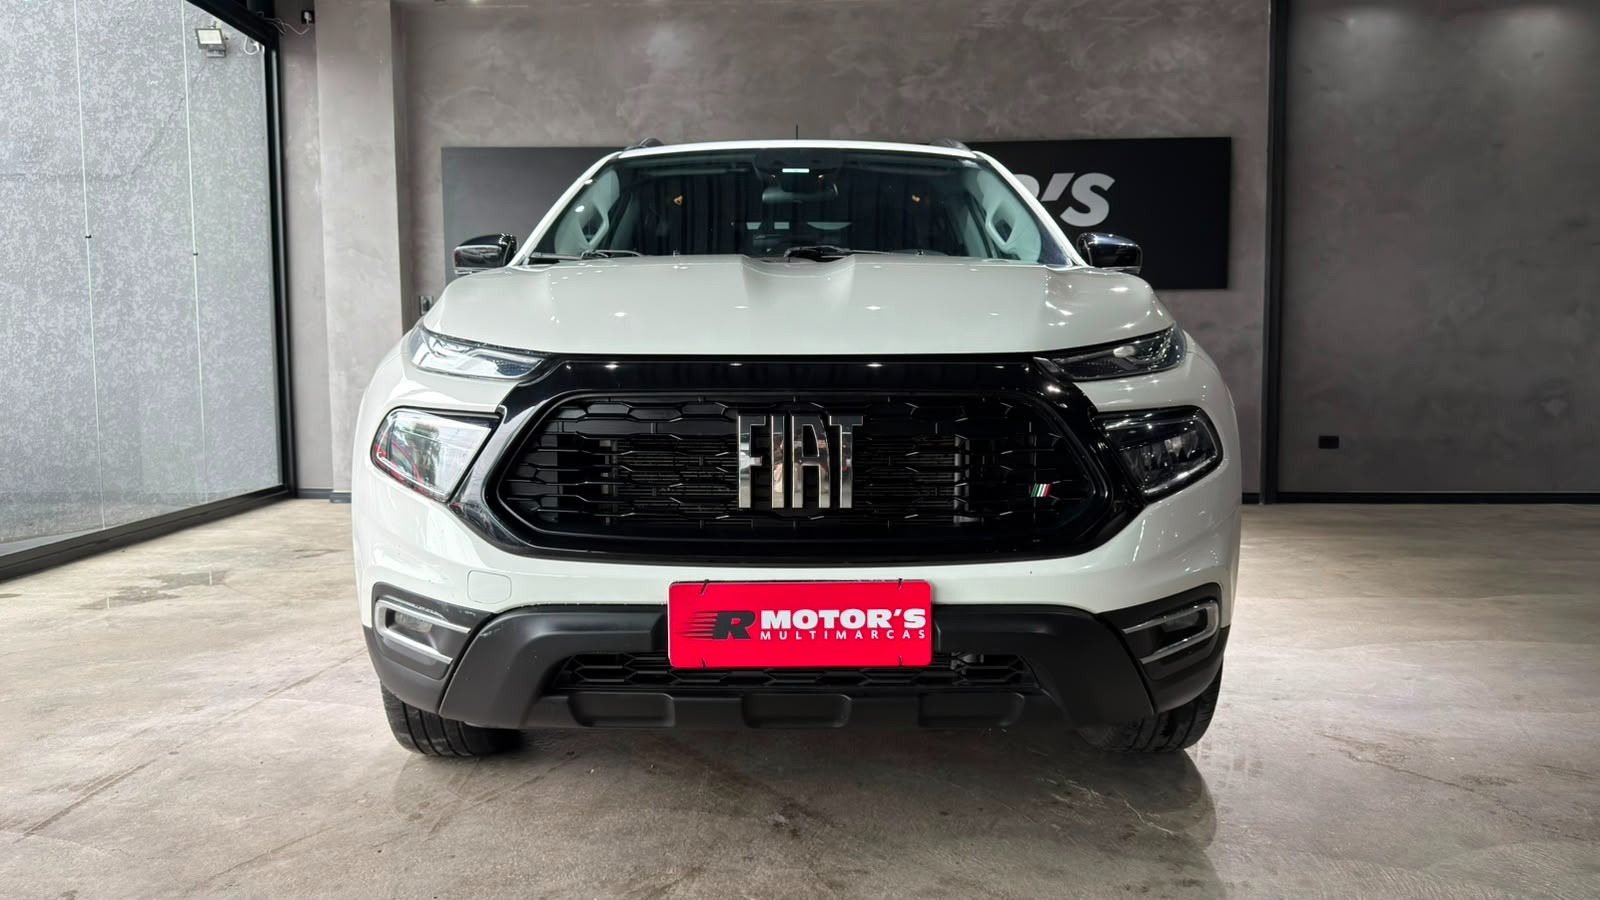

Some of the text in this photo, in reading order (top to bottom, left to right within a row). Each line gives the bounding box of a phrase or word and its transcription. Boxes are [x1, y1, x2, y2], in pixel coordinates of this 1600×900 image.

[738, 415, 863, 508] FIAT
[711, 608, 926, 640] R MOTOR'S
[760, 629, 926, 641] MULTIMARCAS
